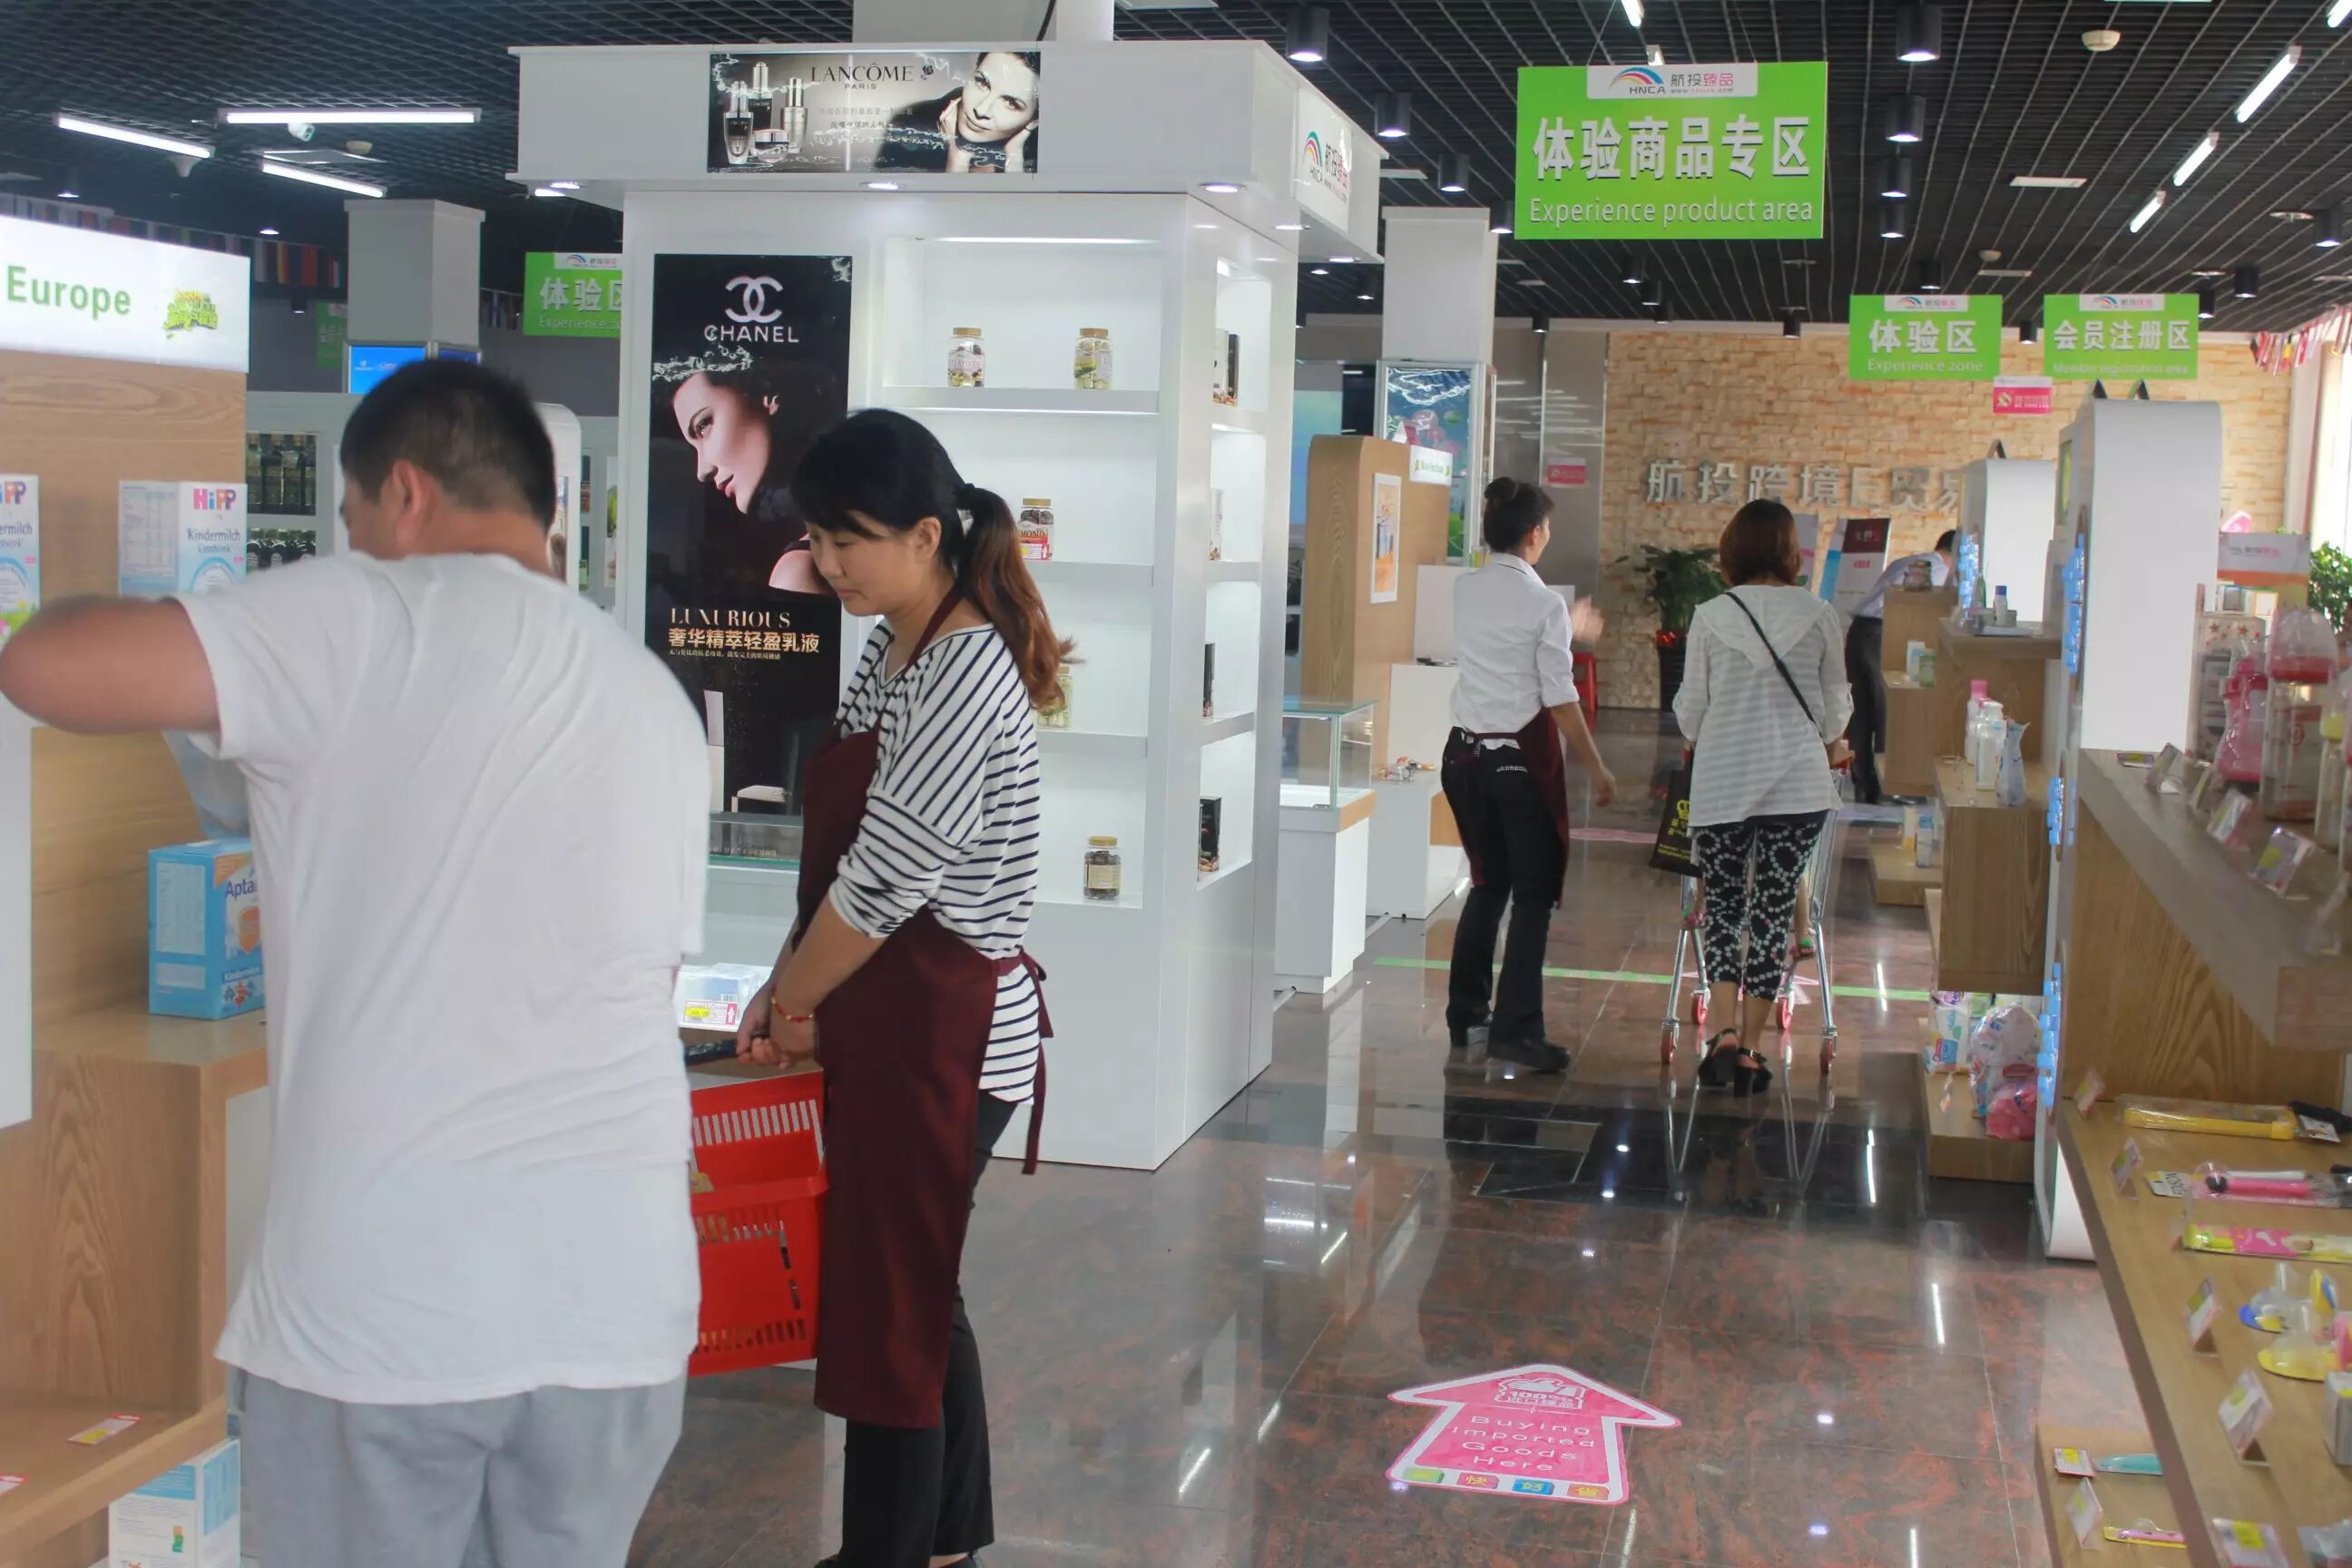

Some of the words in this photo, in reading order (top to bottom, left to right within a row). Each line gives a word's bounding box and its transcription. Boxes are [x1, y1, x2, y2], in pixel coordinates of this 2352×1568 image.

[810, 63, 915, 83] LANCÔME
[1630, 86, 1666, 94] HNCA
[1532, 113, 1810, 181] 体验商品专区
[1530, 197, 1656, 227] Experience
[1662, 196, 1756, 229] product
[1762, 201, 1813, 221] area
[6, 265, 132, 320] Europe
[703, 325, 799, 343] CHANEL
[1868, 319, 1977, 354] 体验区
[2053, 319, 2191, 351] 会员注册区
[1867, 359, 1945, 373] Experience
[1947, 362, 1984, 372] zone
[193, 488, 237, 511] HiPP
[187, 527, 241, 542] Kindermilch
[669, 607, 791, 629] LUXURIOUS
[668, 628, 820, 653] 奢华精萃轻盈乳液
[1452, 1426, 1596, 1447] Imported
[1471, 1416, 1590, 1436] Buying
[1462, 1441, 1577, 1460] Goods
[1473, 1455, 1554, 1471] Here
